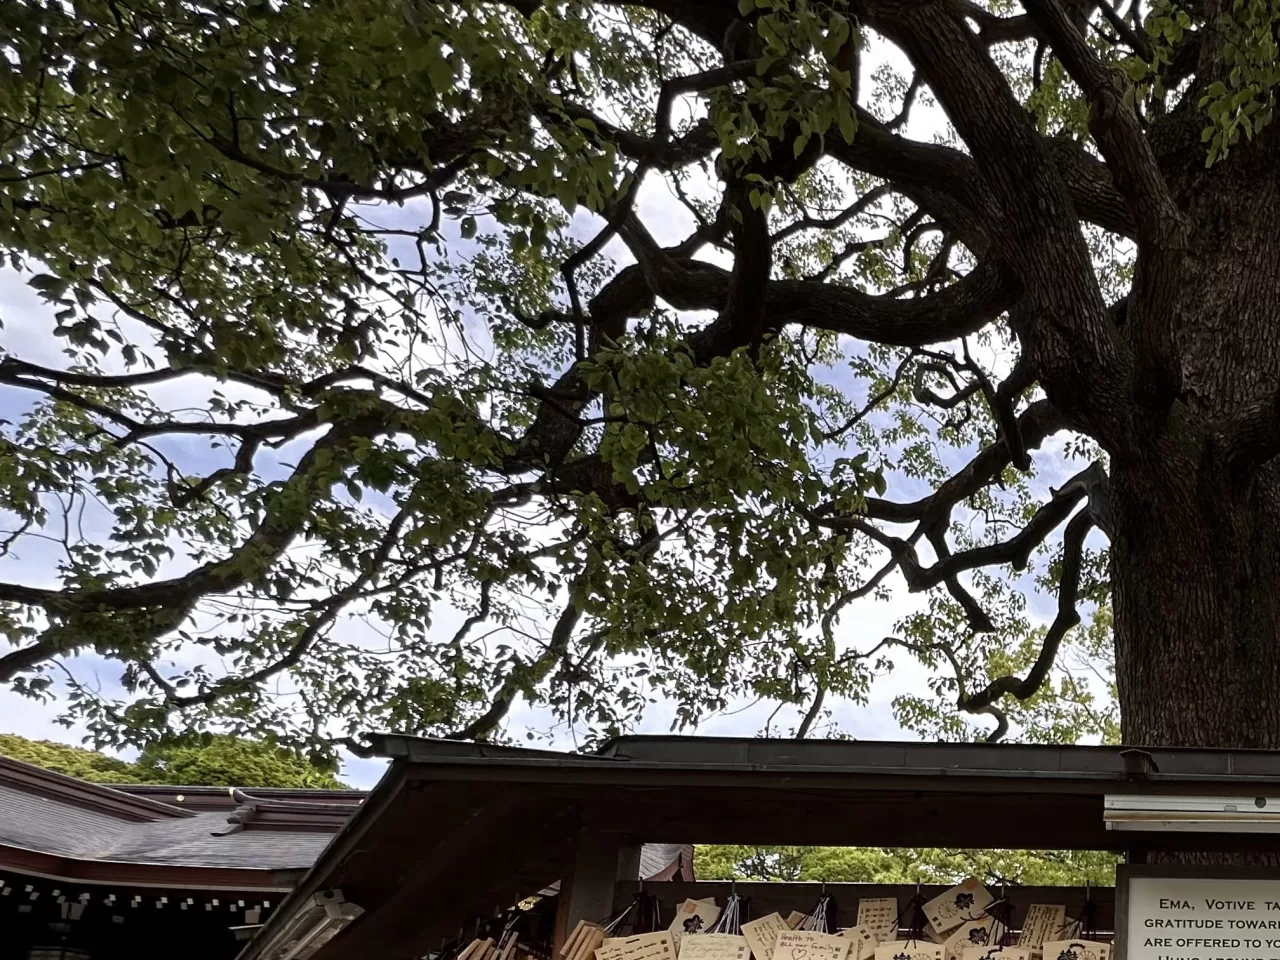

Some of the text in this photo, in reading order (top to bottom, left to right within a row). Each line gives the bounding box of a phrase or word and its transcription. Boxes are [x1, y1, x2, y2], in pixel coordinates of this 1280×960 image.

[1159, 898, 1195, 911] EMA,
[1205, 899, 1255, 910] VOTIVE
[1144, 918, 1224, 929] GRATITUDE
[1143, 937, 1173, 948] ARE
[1175, 938, 1241, 948] OFFERED
[1243, 939, 1262, 949] TO
